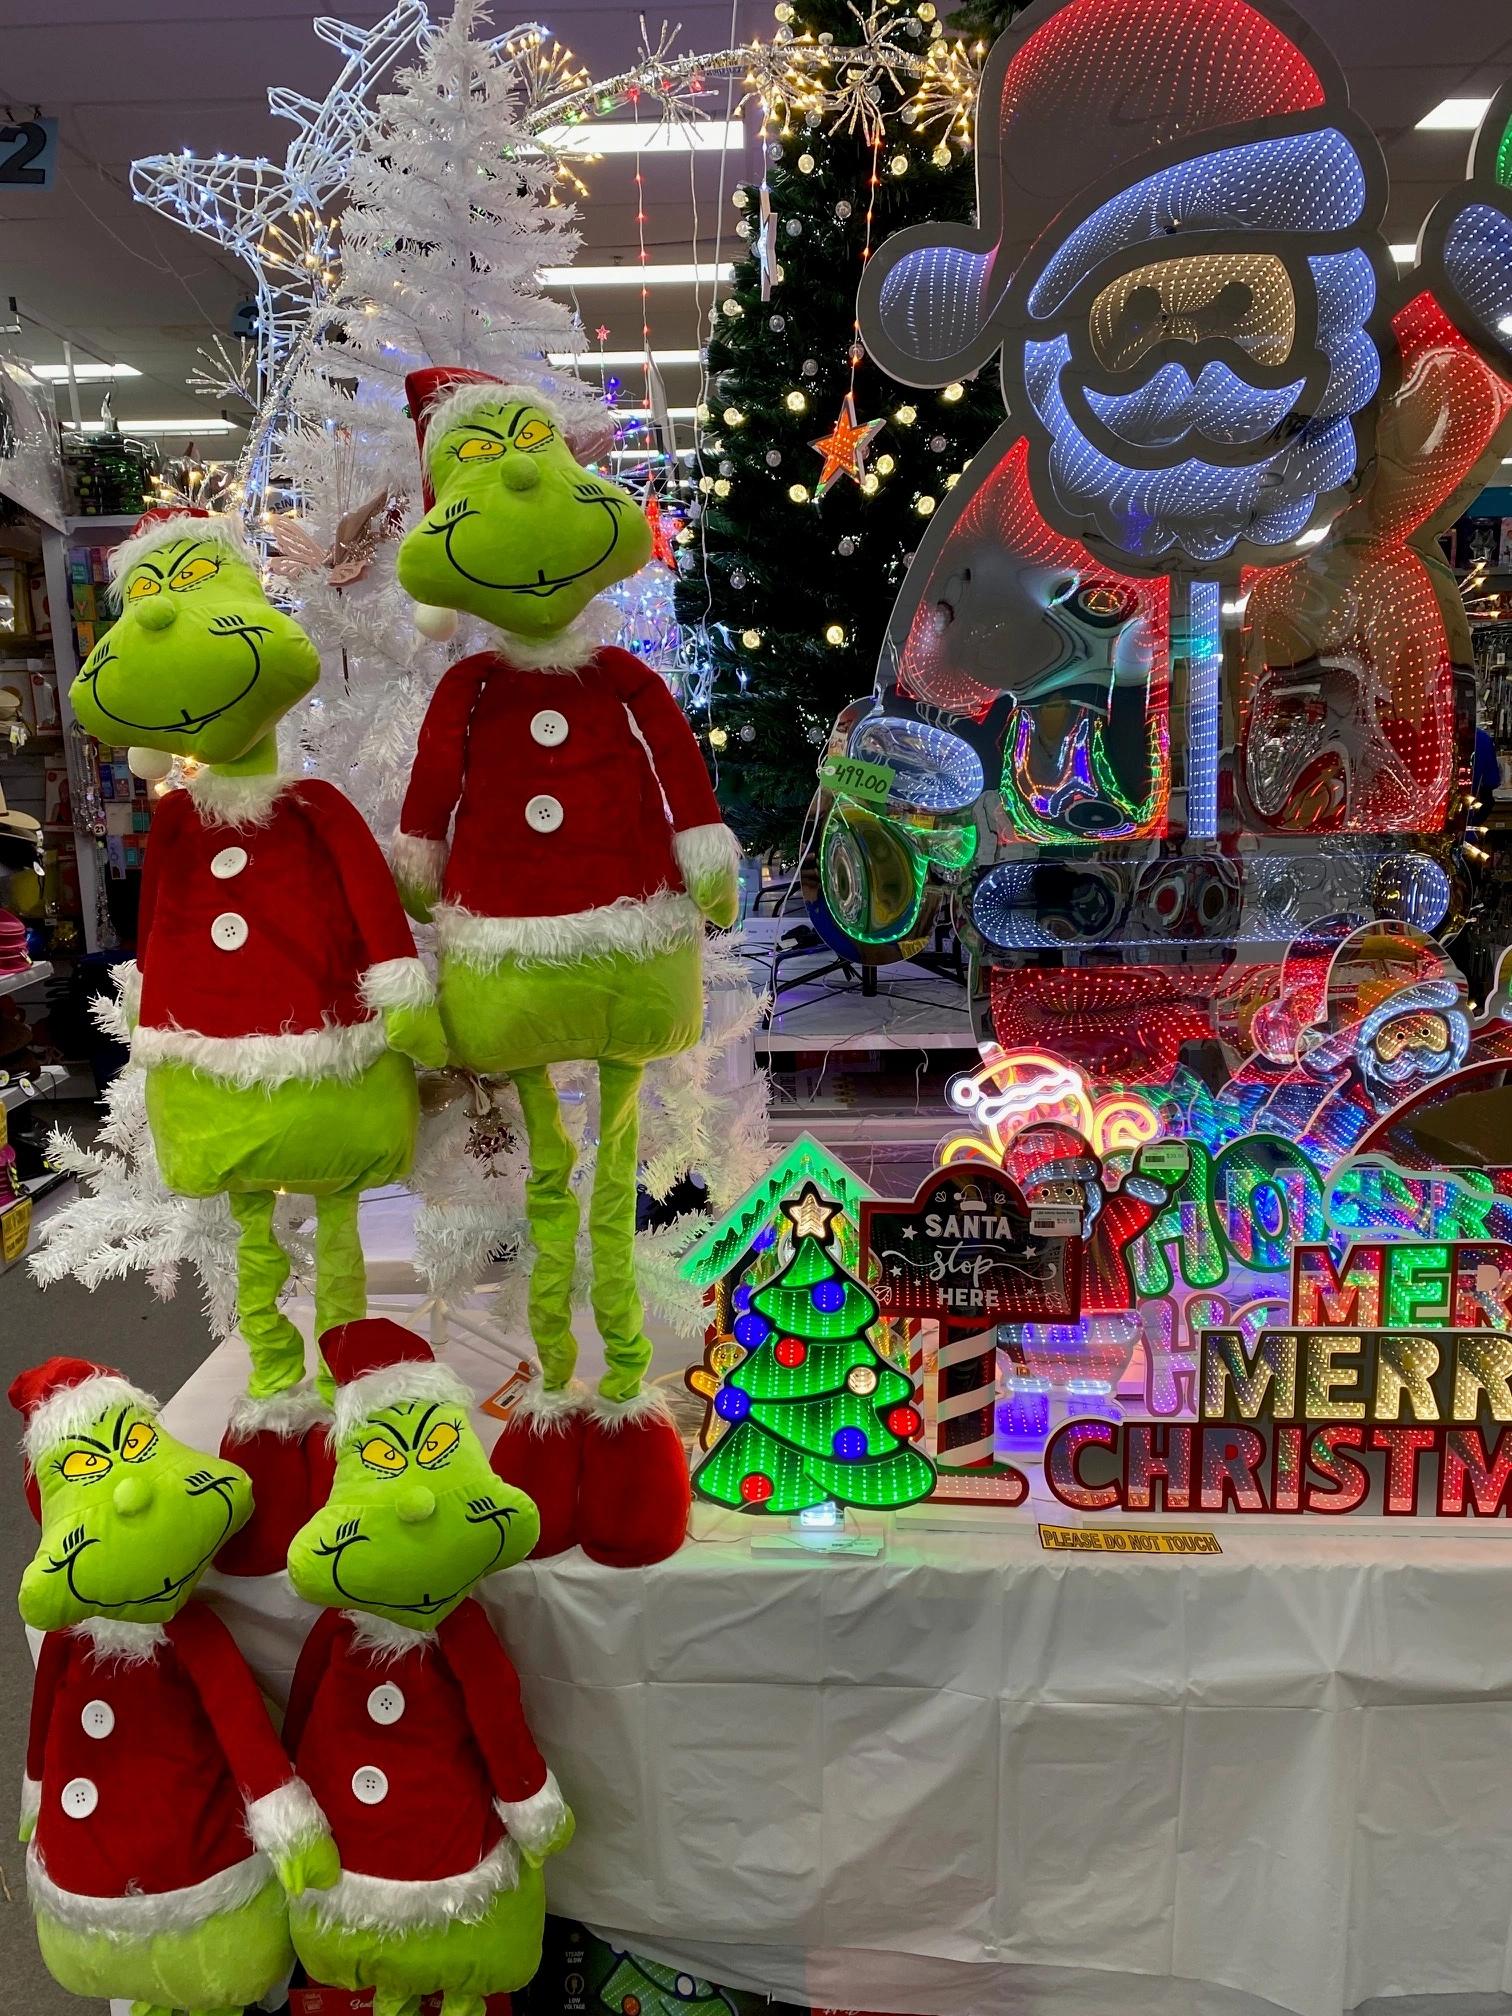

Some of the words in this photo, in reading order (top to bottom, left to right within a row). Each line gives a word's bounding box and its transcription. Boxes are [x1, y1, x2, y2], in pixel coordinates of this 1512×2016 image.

[835, 764, 887, 793] 499.00
[925, 1213, 1013, 1240] SANTA
[938, 1287, 999, 1307] HERE
[1203, 1332, 1512, 1421] MERR
[1046, 1421, 1512, 1514] CHRISTM
[1042, 1530, 1102, 1549] PLEASE
[1103, 1533, 1127, 1551] DO
[1128, 1534, 1162, 1551] NOT
[1163, 1535, 1217, 1552] TOUCH
